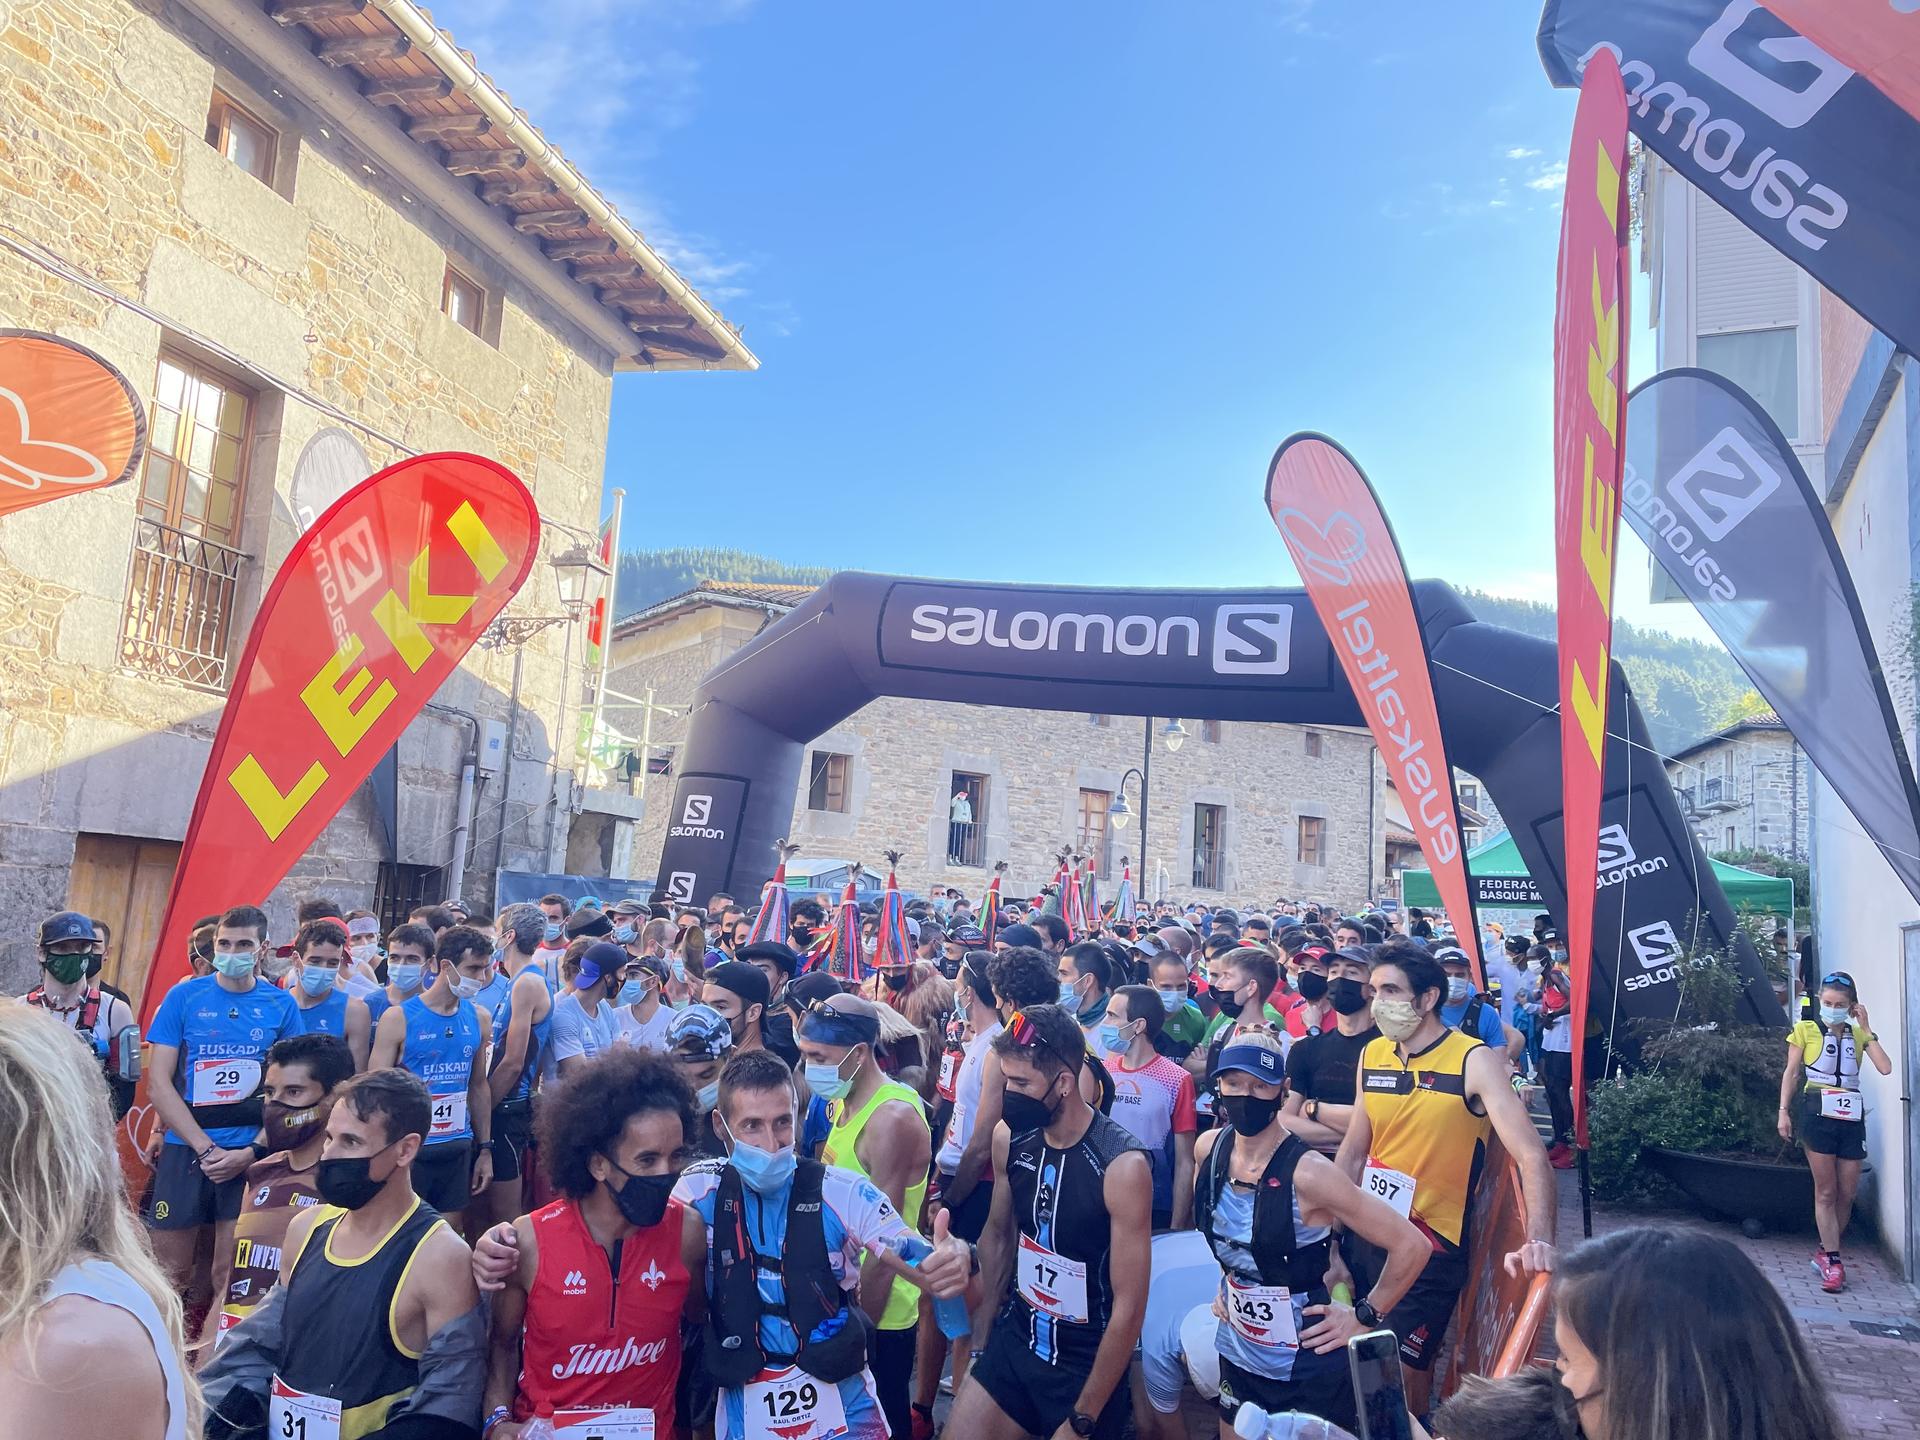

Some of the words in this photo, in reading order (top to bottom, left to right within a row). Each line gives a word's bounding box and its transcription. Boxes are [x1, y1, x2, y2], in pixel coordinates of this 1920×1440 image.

[911, 604, 1200, 656] salomon
[227, 499, 508, 842] LEKI
[1596, 856, 1668, 890] alomon
[1480, 890, 1527, 900] BASQUE
[199, 1044, 260, 1055] EUSKADI
[214, 1070, 240, 1085] 29
[434, 1104, 453, 1118] 41
[1125, 1096, 1141, 1105] BASE
[1836, 1098, 1851, 1108] 12
[1370, 1173, 1400, 1201] 597
[1034, 1263, 1058, 1288] 17
[563, 1287, 587, 1295] mobel
[1232, 1293, 1274, 1321] 343
[552, 1336, 667, 1380] Jimbee
[763, 1383, 818, 1417] 129
[282, 1410, 307, 1440] 31
[792, 1412, 811, 1421] ORTIZ
